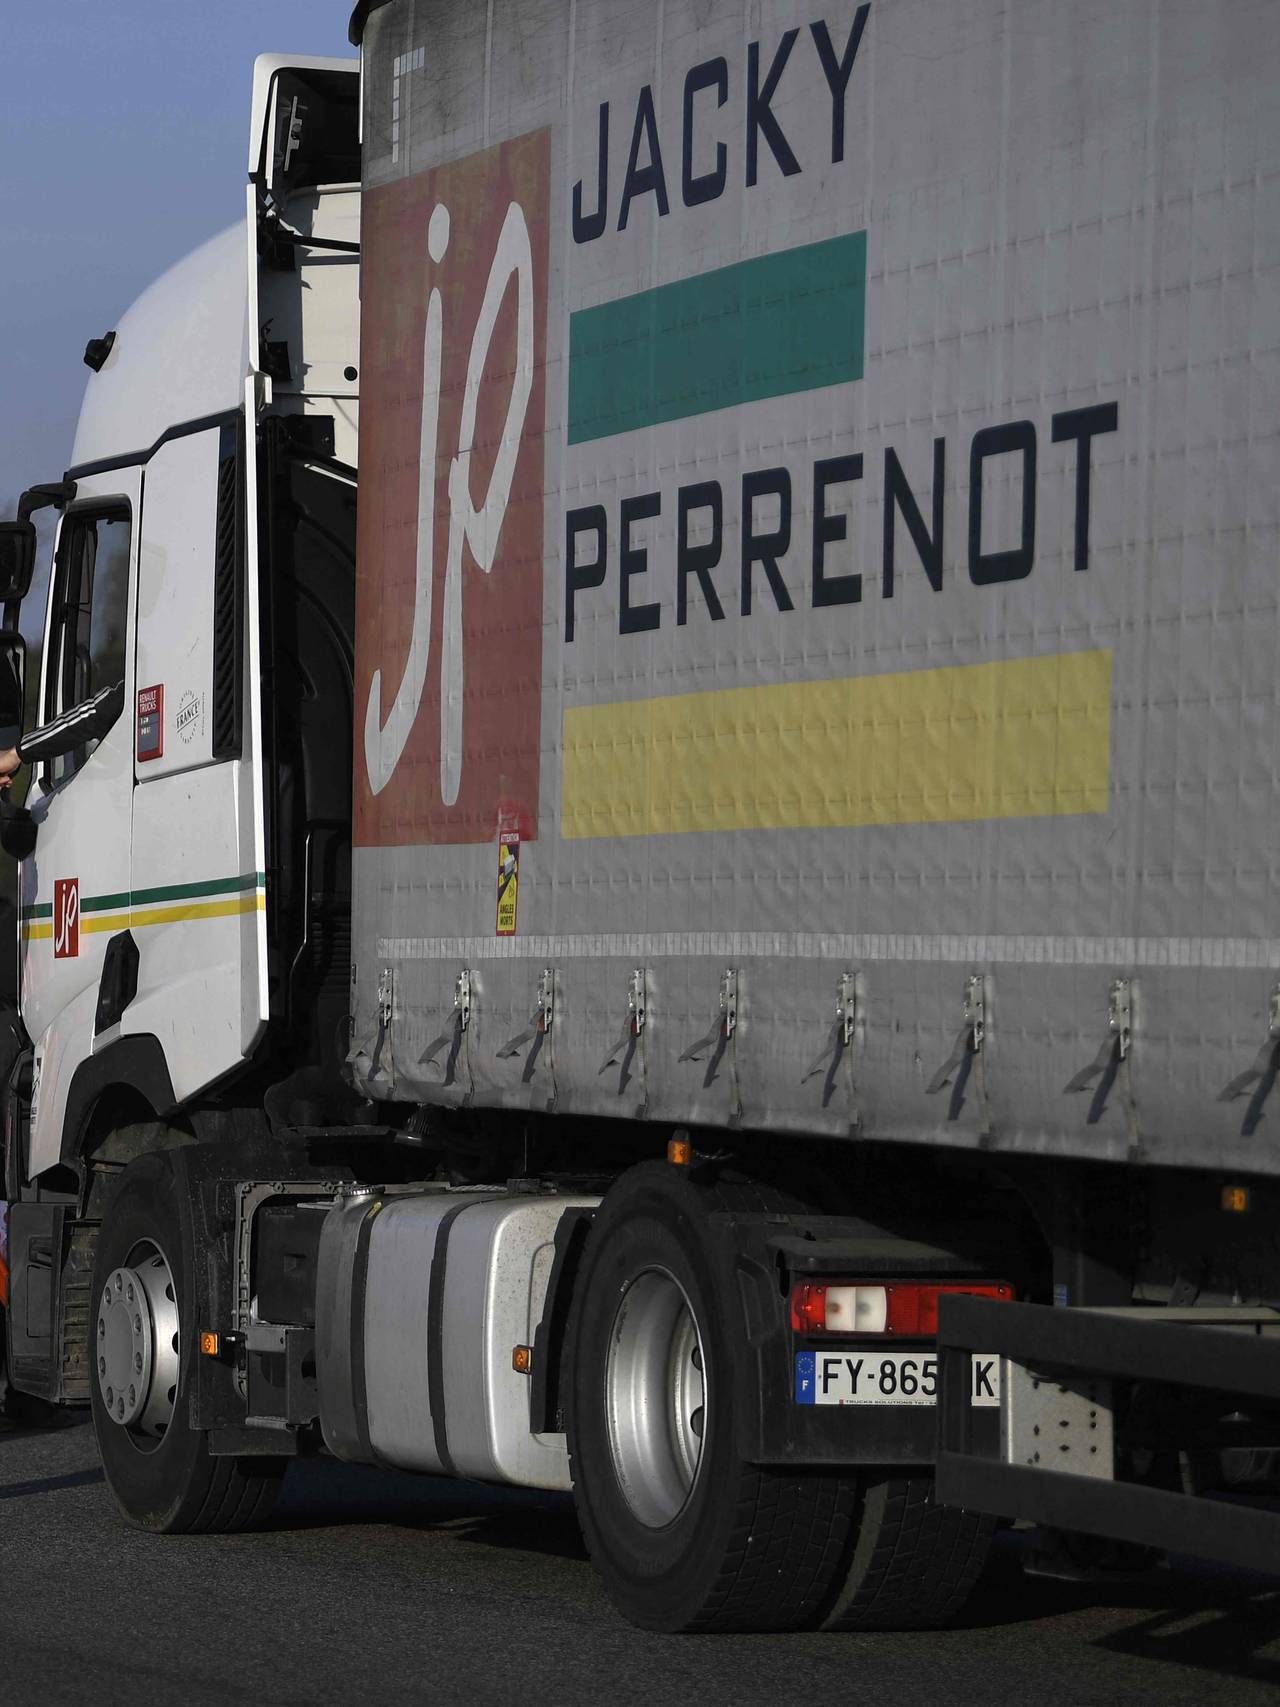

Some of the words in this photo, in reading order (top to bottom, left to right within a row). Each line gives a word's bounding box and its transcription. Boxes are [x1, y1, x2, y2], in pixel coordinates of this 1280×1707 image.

[571, 3, 872, 244] JACKY
[565, 400, 1119, 643] PERRENOT
[802, 1380, 809, 1391] F
